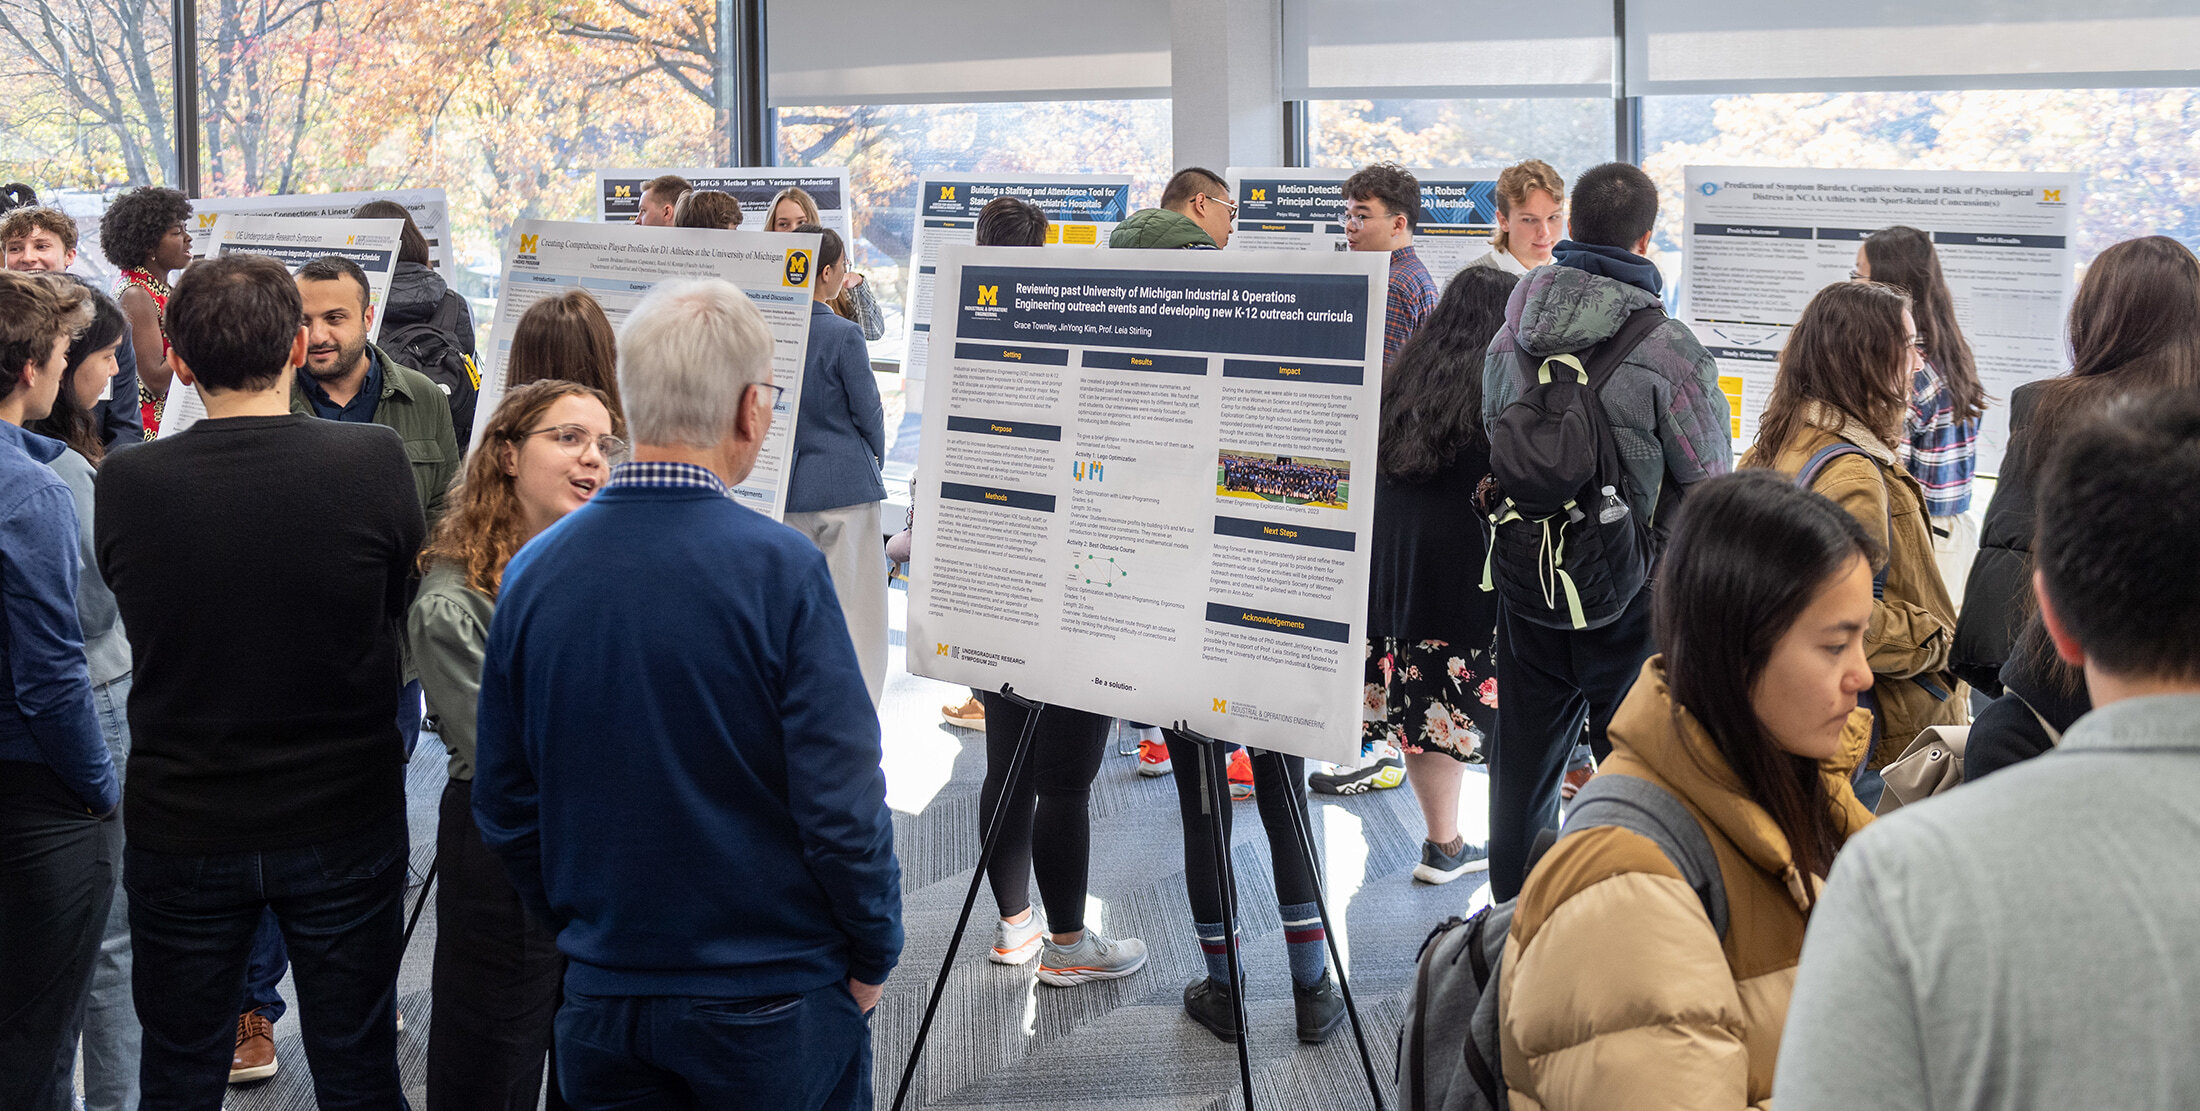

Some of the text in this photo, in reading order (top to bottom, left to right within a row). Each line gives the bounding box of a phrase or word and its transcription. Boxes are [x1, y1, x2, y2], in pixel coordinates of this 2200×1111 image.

[723, 178, 747, 186] Method
[615, 185, 630, 197] M
[941, 187, 955, 200] M
[970, 185, 998, 196] Building
[1005, 186, 1032, 196] Staffing
[1033, 186, 1046, 195] and
[1047, 186, 1087, 195] Attendance
[1088, 187, 1104, 196] Tool
[1104, 187, 1116, 196] for
[1251, 189, 1266, 200] M
[1278, 185, 1342, 194] Motion Detectio
[1435, 186, 1466, 195] Robust
[1724, 181, 1764, 190] Prediction
[1765, 182, 1774, 190] of
[1776, 182, 1814, 192] Symptom
[1816, 183, 1848, 192] Burden,
[1850, 184, 1890, 193] Cognitive
[1893, 185, 1921, 194] Status,
[1924, 185, 1940, 193] and
[1963, 186, 1973, 194] of
[1974, 186, 2033, 196] Psychological
[1796, 194, 1822, 202] NCAA
[1879, 196, 1938, 205] Sport-Related
[1940, 198, 2000, 208] Concussion(s)
[2043, 189, 2061, 201] M
[970, 198, 988, 206] State
[1030, 199, 1101, 210] Psychiatric Hospitals
[1278, 197, 1313, 207] Principal
[1315, 198, 1348, 208] Compon
[1436, 199, 1475, 208] Methods
[198, 213, 218, 227] M
[520, 234, 539, 253] M
[541, 239, 783, 262] Creating Comprehensive Player Profiles for D1 Athletes at the University of Michigan
[790, 257, 806, 273] M
[977, 285, 998, 305] M
[1016, 283, 1296, 304] Reviewing past University of Michigan Industrial & Operations
[1014, 298, 1354, 321] Engineering outreach events and developing new K-12 outreach curricula
[1013, 320, 1152, 336] Grace Townley, JinYong Kim, Prof. Leia Stirling
[1003, 351, 1021, 360] Setting
[1722, 348, 1740, 358] Study
[1131, 358, 1152, 366] Results
[1279, 366, 1300, 376] Impact
[991, 424, 1012, 433] Purpose
[1075, 450, 1091, 459] Activity
[1096, 452, 1108, 460] Lego
[1108, 453, 1136, 462] Optimization
[985, 492, 1007, 501] Methods
[1216, 497, 1233, 505] Summer
[1234, 499, 1259, 509] Engineering
[1259, 501, 1284, 510] Exploration
[1285, 504, 1306, 513] Campers,
[1264, 526, 1298, 538] Next Steps
[1067, 538, 1083, 548] Activity
[1088, 540, 1099, 548] Best
[1099, 542, 1118, 551] Obstacle
[1119, 544, 1136, 553] Course
[1242, 612, 1304, 629] Acknowledgements
[937, 643, 949, 656] M
[1264, 636, 1274, 644] PhD
[1275, 639, 1293, 647] student
[1294, 641, 1312, 652] JinYong
[1312, 644, 1322, 653] Kim,
[961, 654, 987, 664] SYMPOSIUM
[962, 648, 1025, 664] UNDERGRADUATE RESEARCH
[1094, 677, 1102, 685] Be
[1108, 681, 1132, 691] solution
[1212, 698, 1227, 714] M
[1231, 705, 1257, 716] INDUSTRIAL
[1263, 710, 1292, 722] OPERATIONS
[1293, 716, 1325, 728] ENGINEERING
